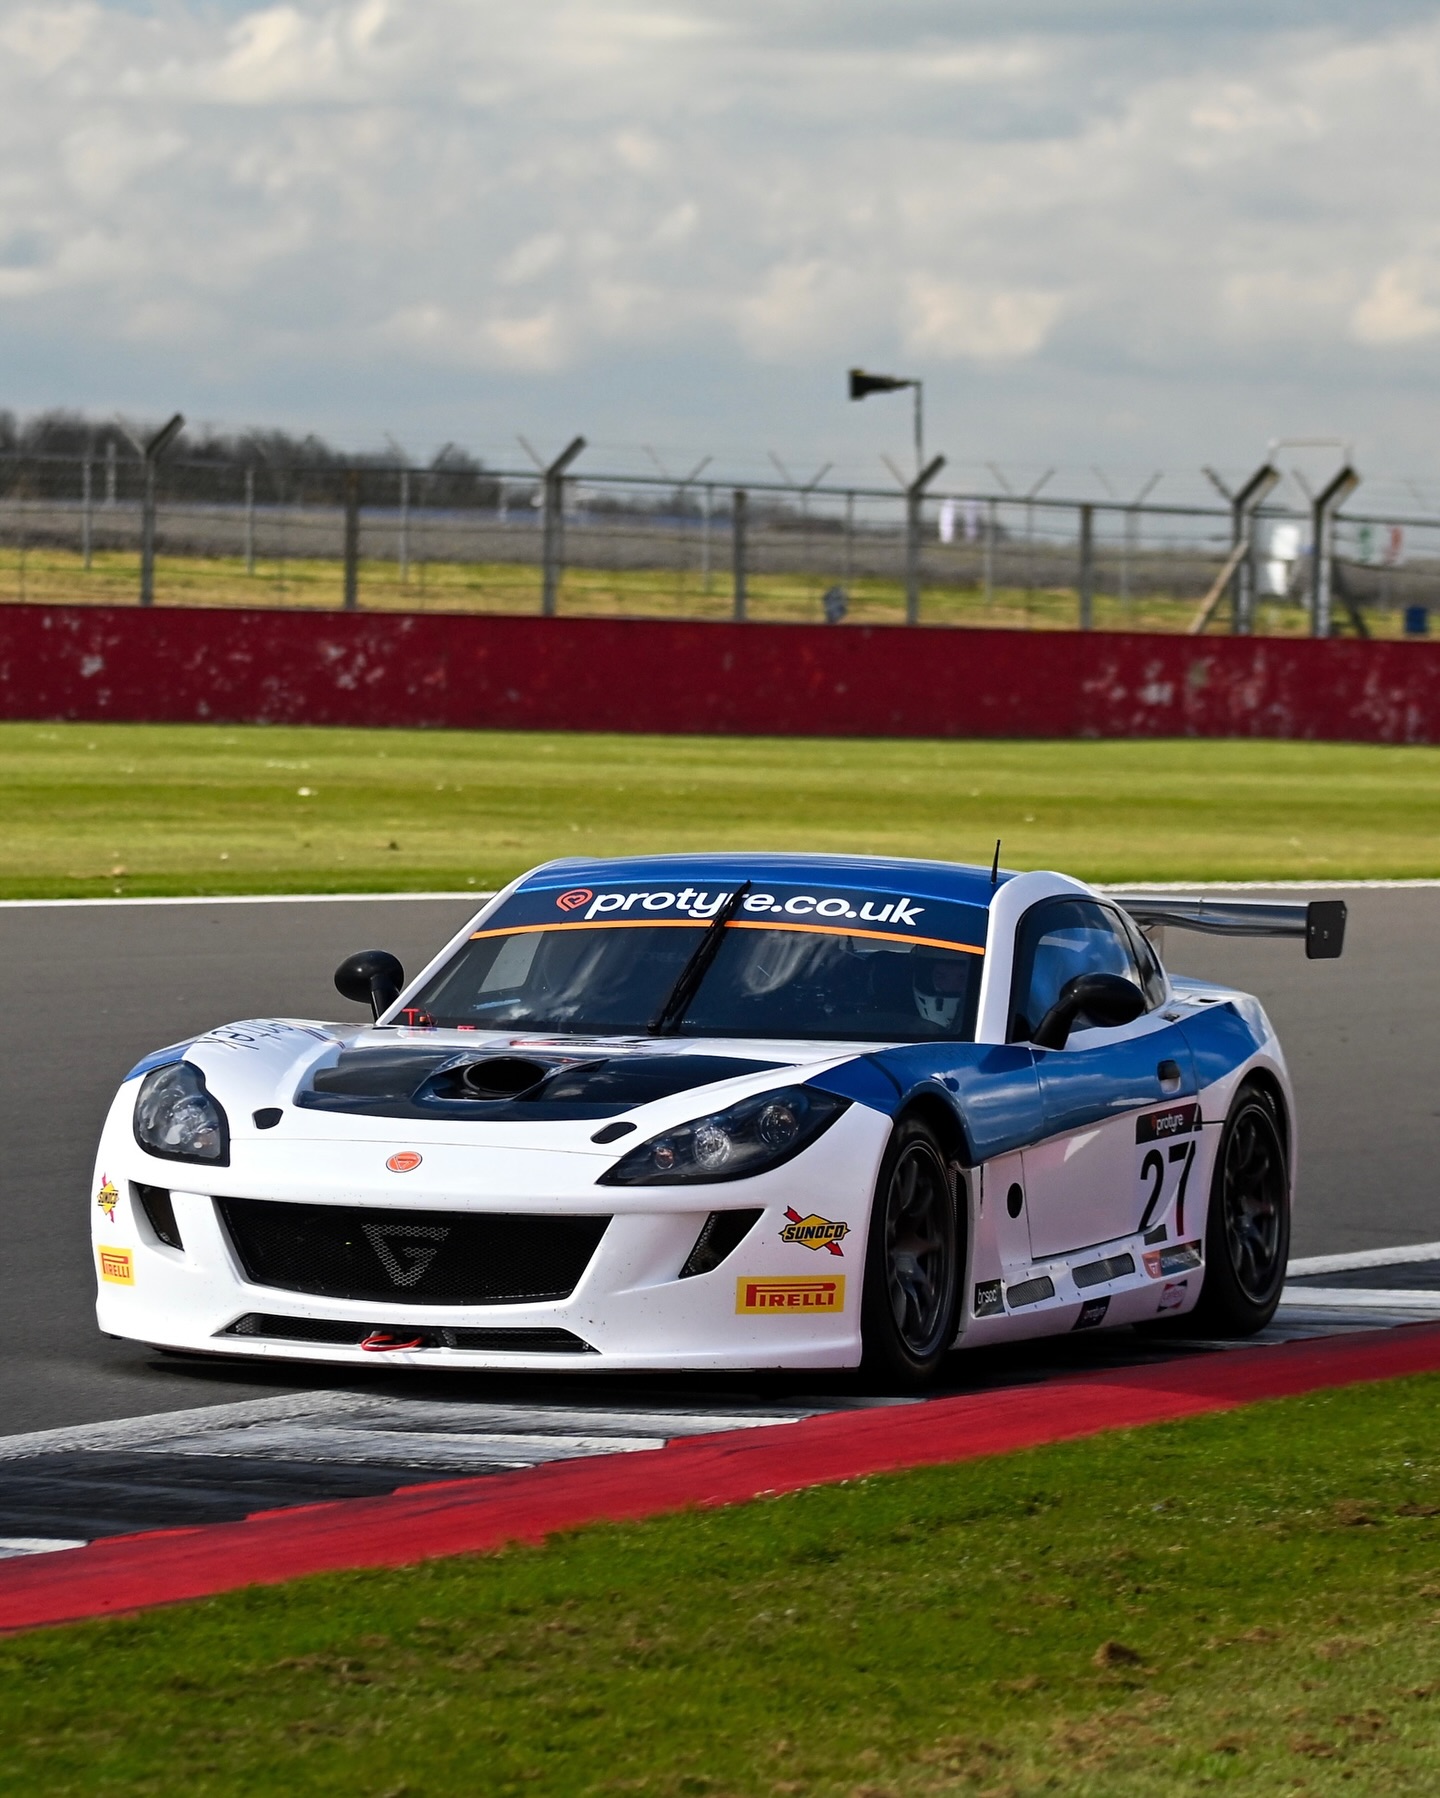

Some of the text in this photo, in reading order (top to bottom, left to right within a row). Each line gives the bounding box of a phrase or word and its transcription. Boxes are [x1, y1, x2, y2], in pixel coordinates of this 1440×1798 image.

[1156, 1113, 1184, 1136] protyre
[1138, 1140, 1197, 1245] 27
[784, 1225, 845, 1240] SUNOCO
[101, 1253, 131, 1279] PIRELLI
[745, 1282, 837, 1307] PIRELLI
